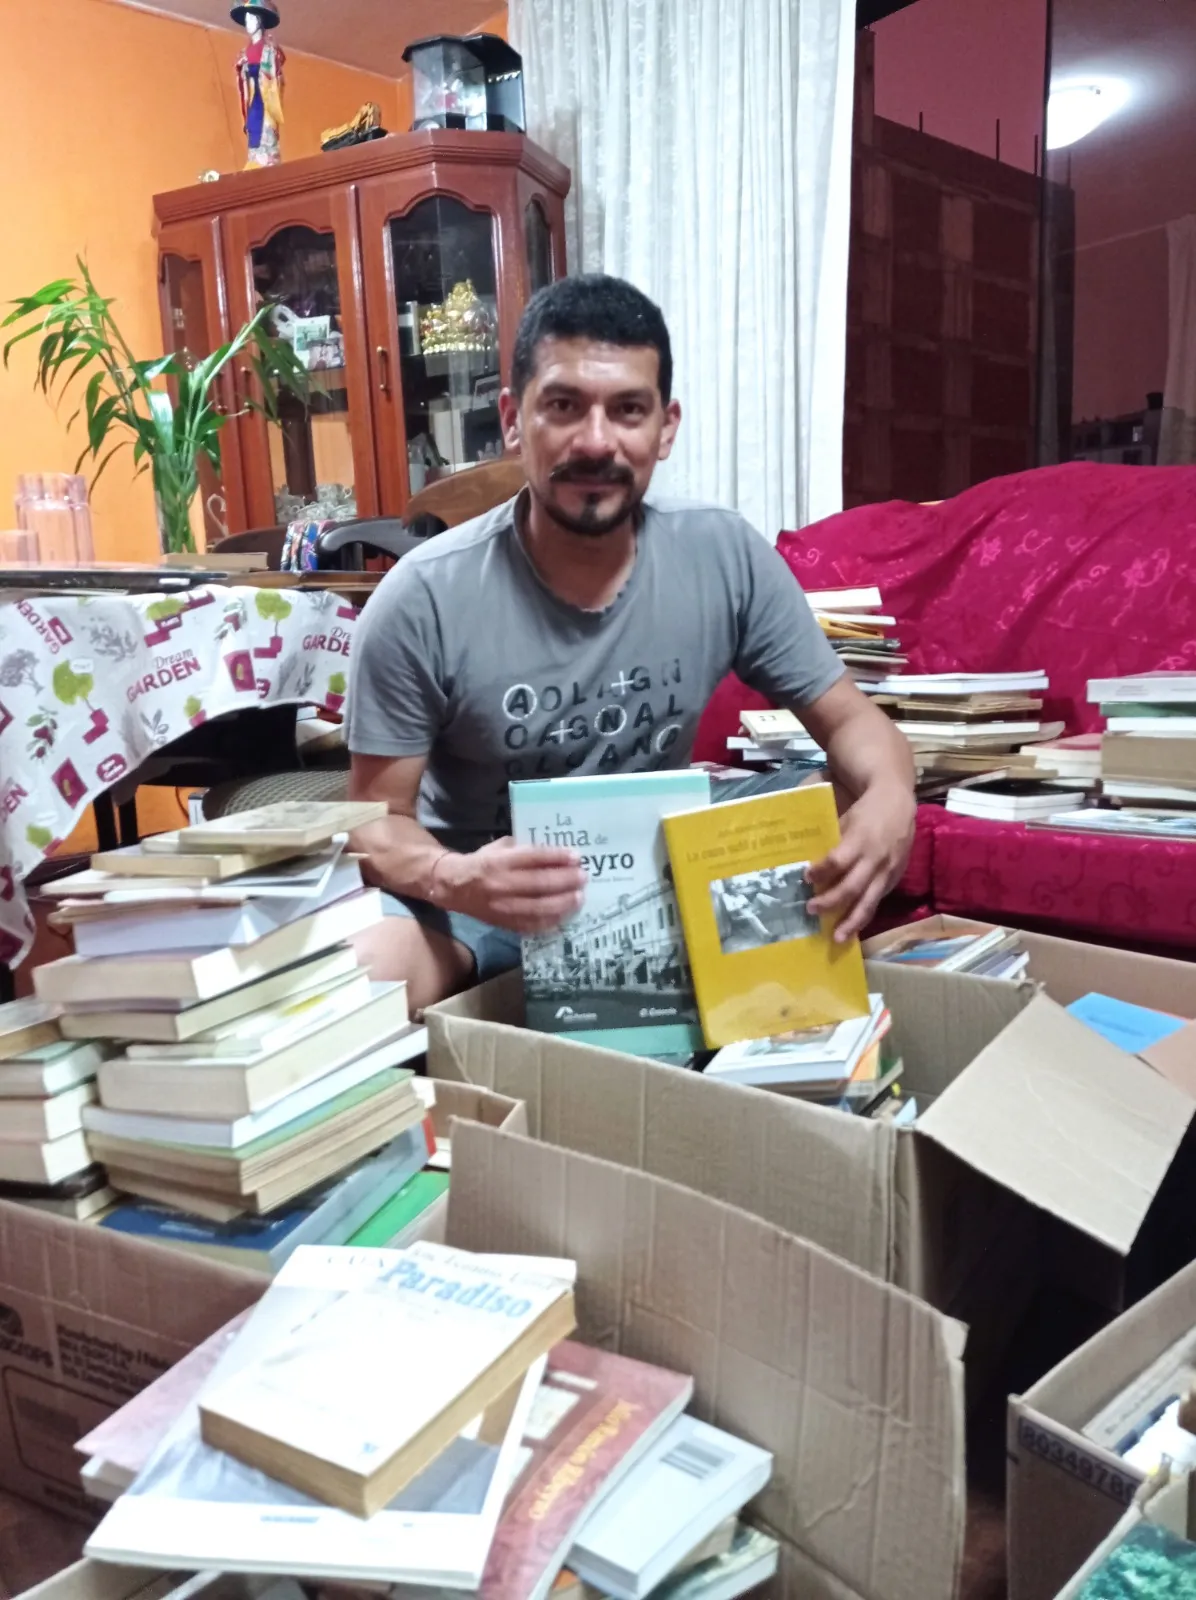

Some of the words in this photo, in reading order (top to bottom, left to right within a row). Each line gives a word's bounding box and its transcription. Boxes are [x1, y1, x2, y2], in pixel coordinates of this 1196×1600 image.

[330, 626, 352, 641] Dre
[303, 635, 350, 657] GARDE
[155, 648, 194, 669] Dream
[126, 656, 202, 703] GARDEN
[556, 813, 573, 827] La
[528, 825, 591, 847] Lima
[594, 834, 609, 845] de
[579, 852, 635, 877] eyro
[378, 1257, 533, 1318] Paradiso
